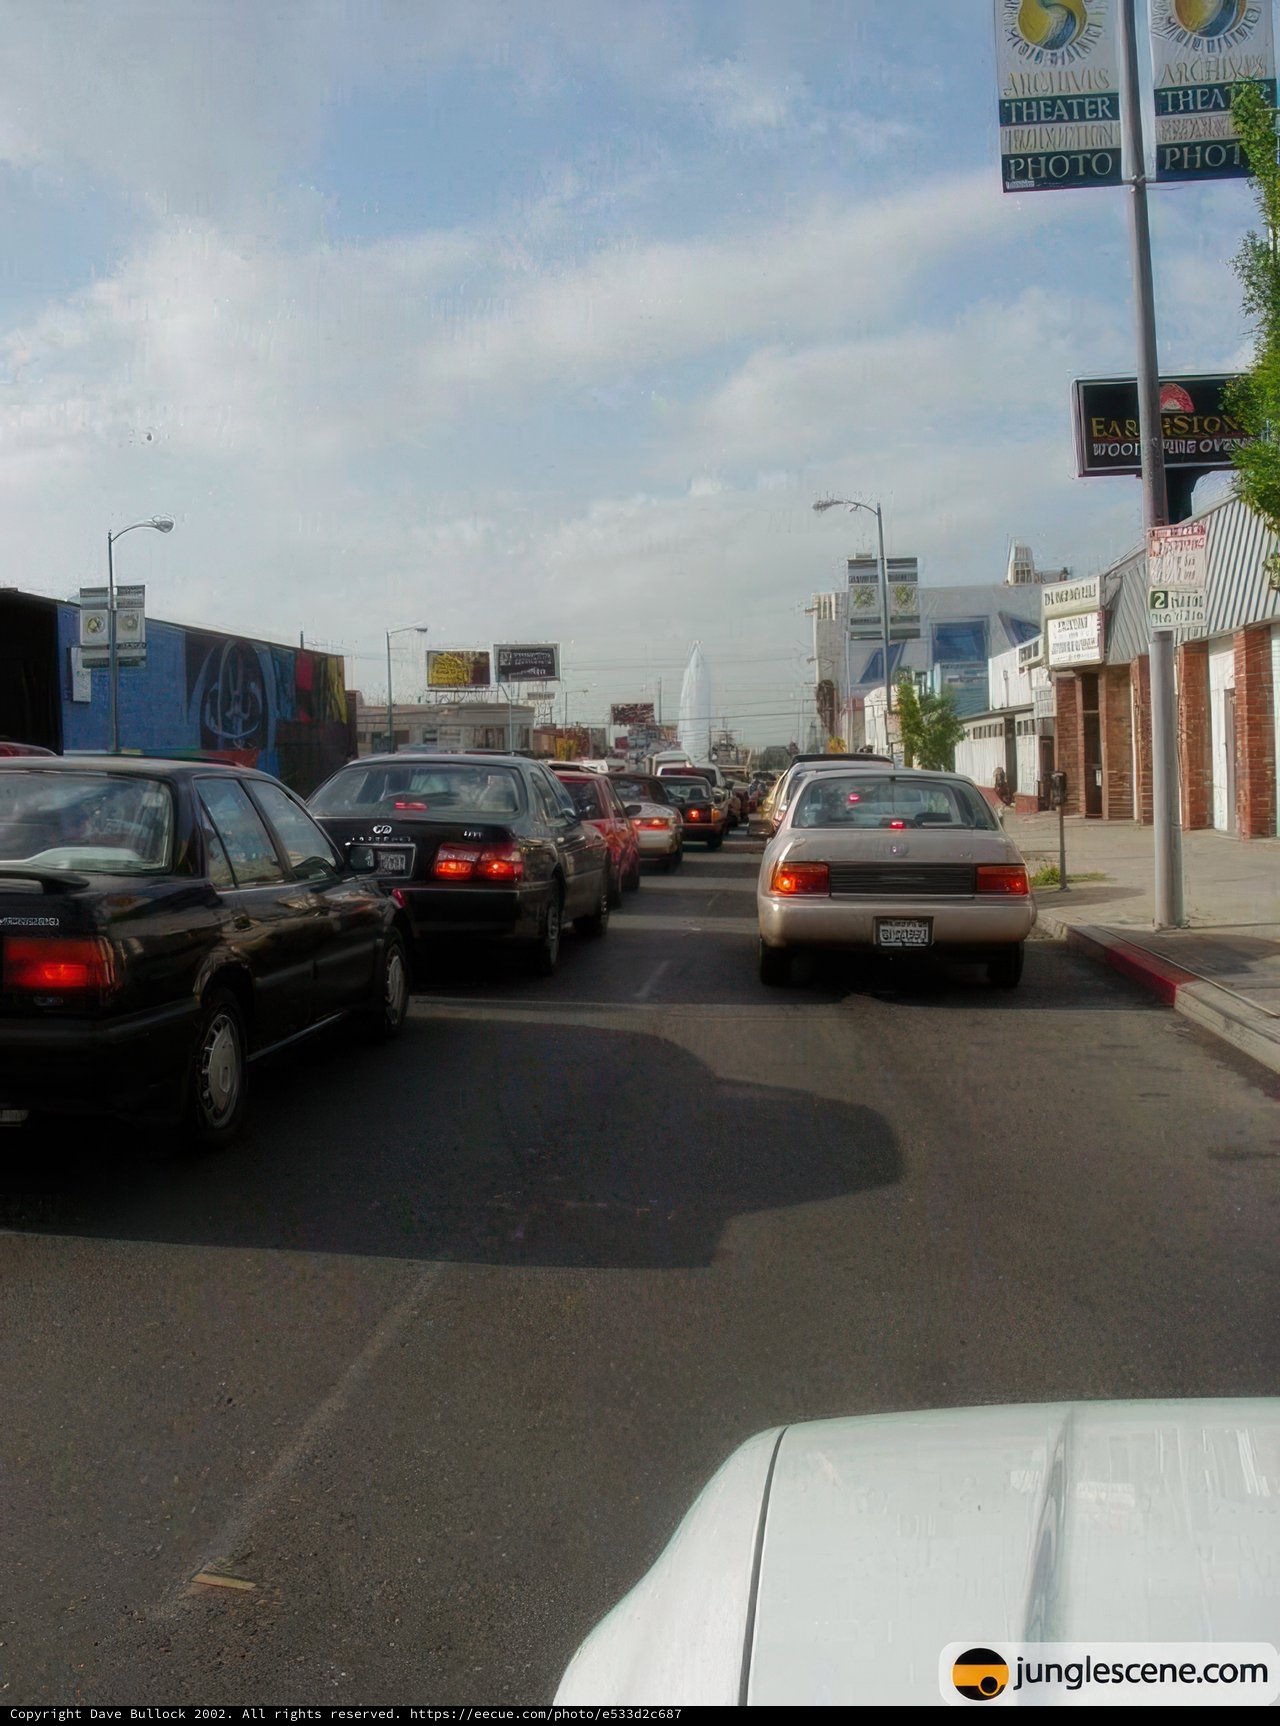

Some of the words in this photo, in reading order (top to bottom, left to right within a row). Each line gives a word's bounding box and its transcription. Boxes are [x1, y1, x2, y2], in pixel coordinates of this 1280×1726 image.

[1005, 97, 1113, 123] THEATER
[1159, 86, 1240, 112] THEAT
[1007, 151, 1113, 180] PHOTO
[1161, 142, 1243, 170] PHOT
